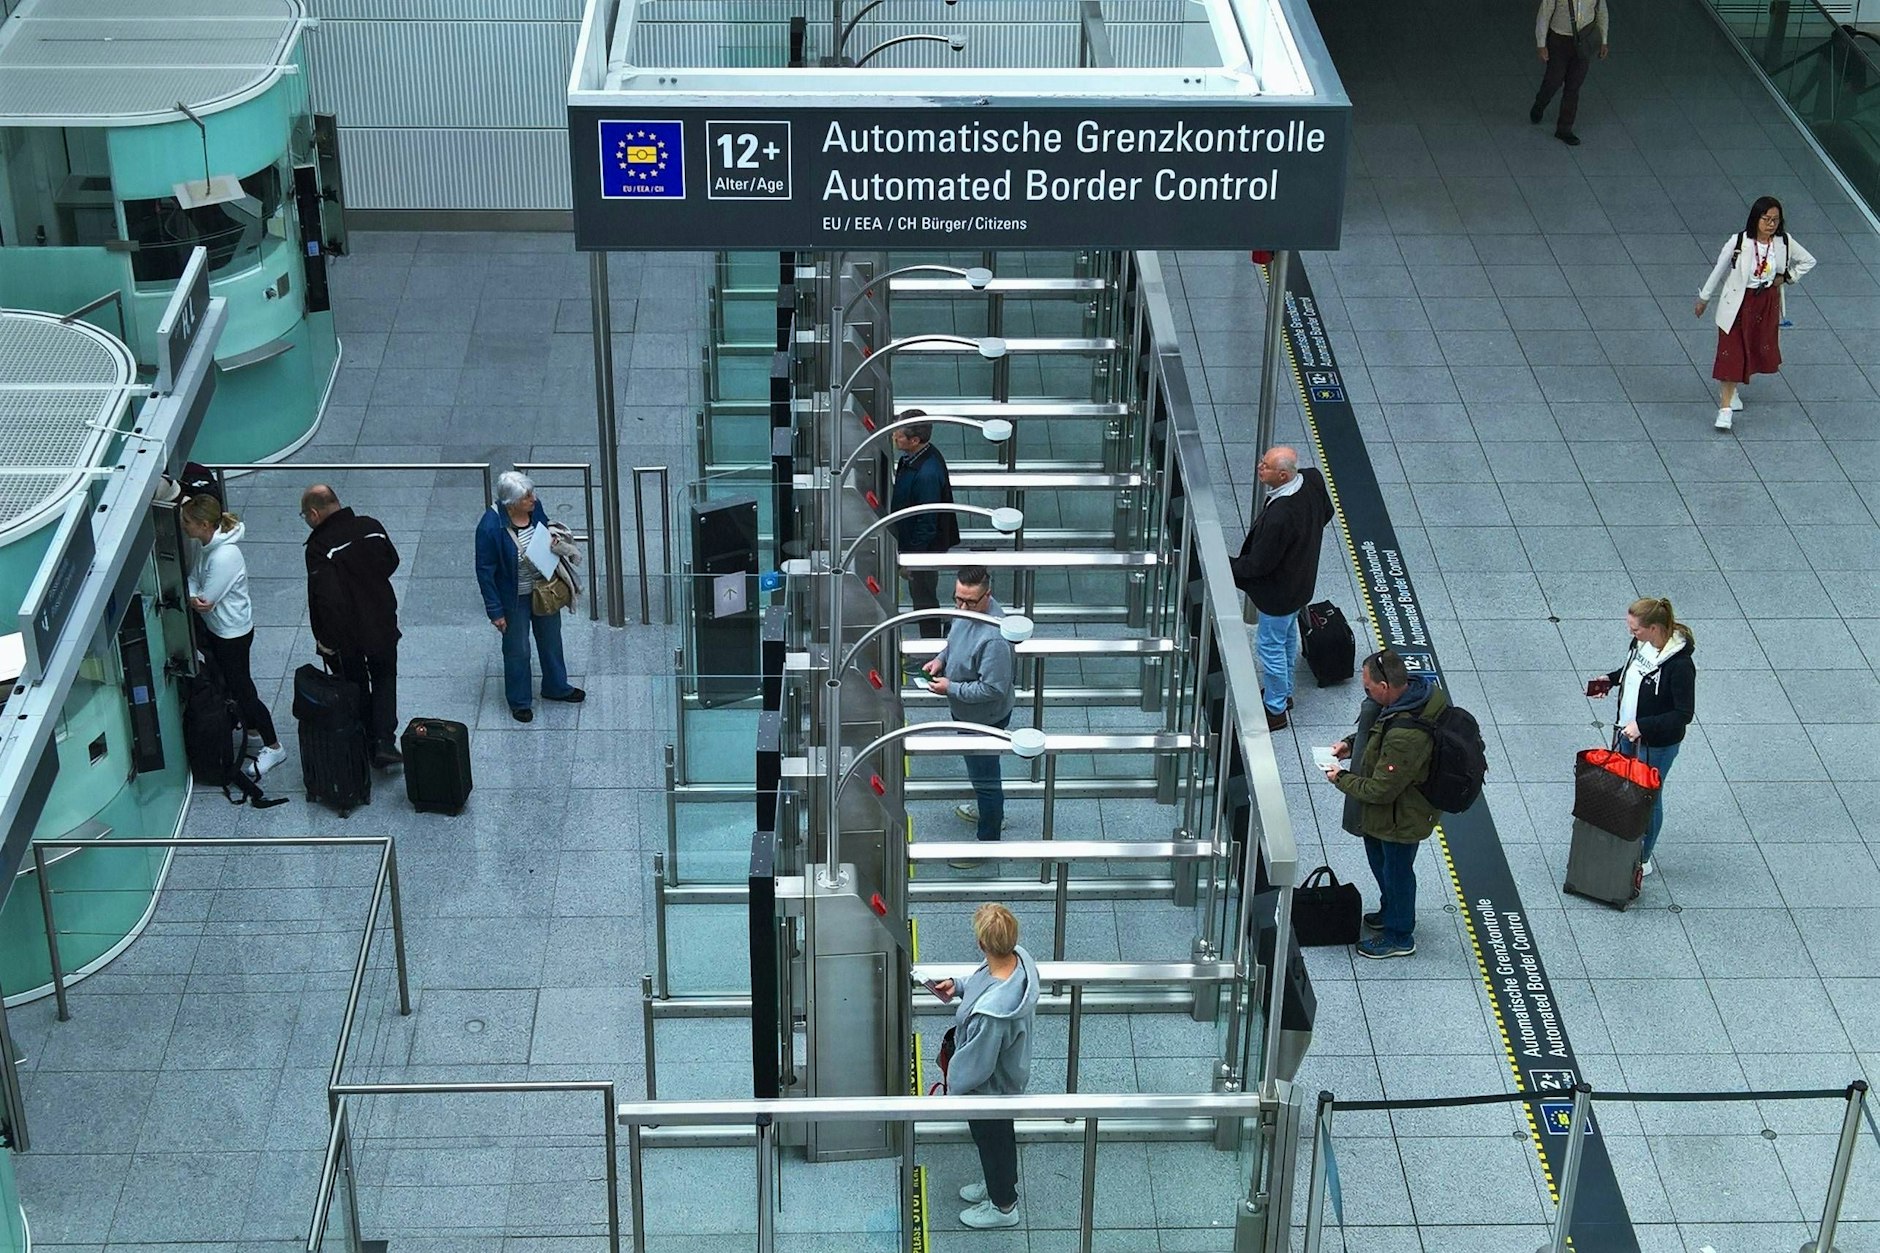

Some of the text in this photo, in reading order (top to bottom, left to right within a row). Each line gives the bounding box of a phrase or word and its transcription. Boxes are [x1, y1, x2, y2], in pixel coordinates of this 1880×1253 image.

[716, 133, 781, 169] 12+
[821, 120, 1325, 153] Automatische Grenzkontrolle
[714, 176, 784, 193] Alter/Age
[822, 168, 1278, 201] Automated Border Control
[822, 216, 842, 231] EU
[854, 216, 883, 231] EEA
[897, 216, 917, 231] CH
[1361, 541, 1407, 647] Automatische Grenzkontrolle
[1382, 549, 1427, 647] Automated Border Control
[1403, 655, 1421, 671] 12+
[1476, 898, 1542, 1058] Automatische Grenzkontrolle
[1502, 911, 1568, 1058] Automated Border Control
[1540, 1073, 1561, 1091] 2+
